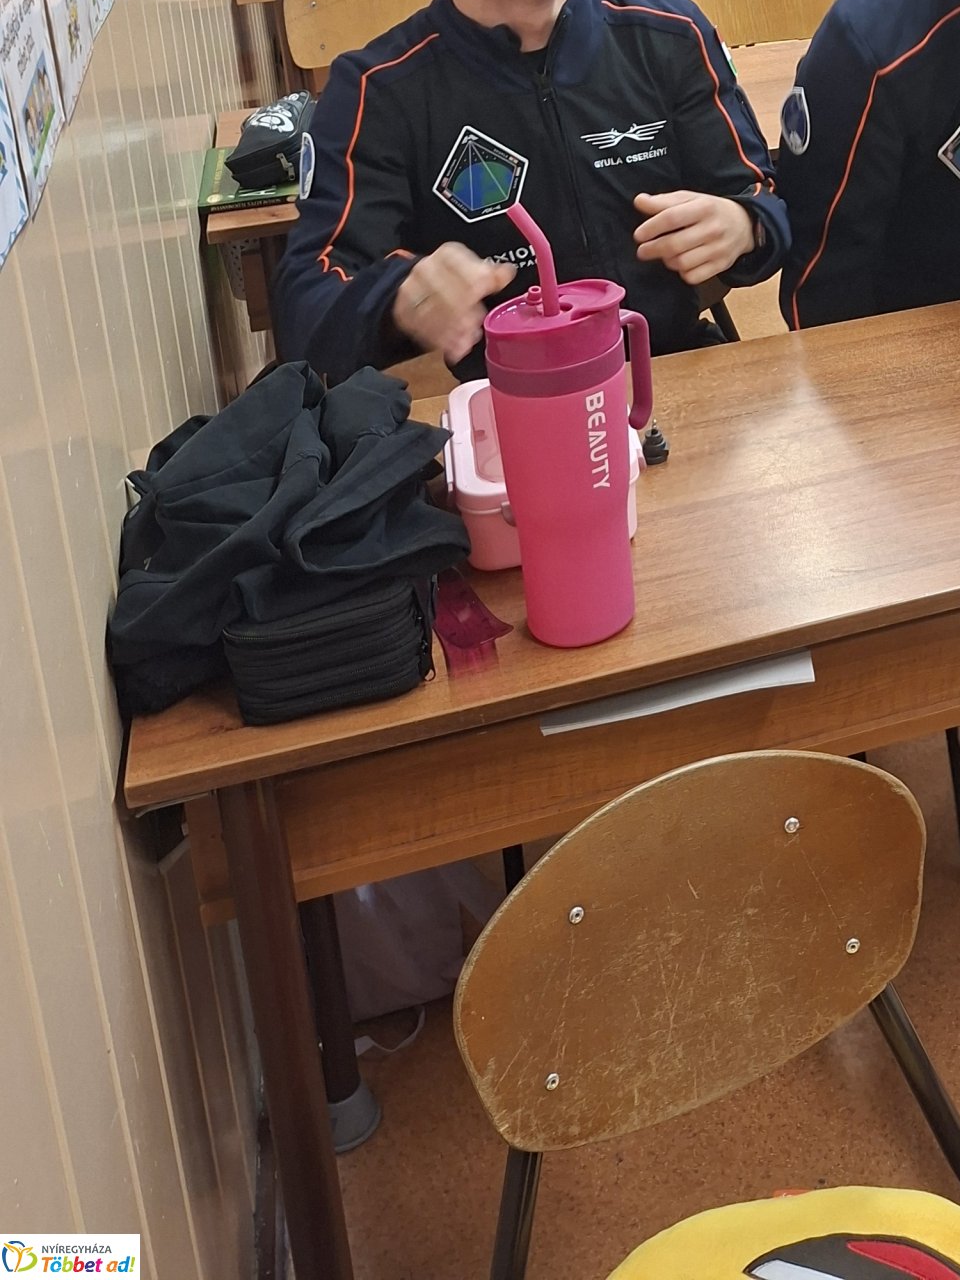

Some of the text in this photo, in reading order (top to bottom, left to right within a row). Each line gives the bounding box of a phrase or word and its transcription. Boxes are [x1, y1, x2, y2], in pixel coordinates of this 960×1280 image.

[594, 146, 668, 168] GYULA CSERÉNYI
[584, 390, 610, 489] BEAUTY
